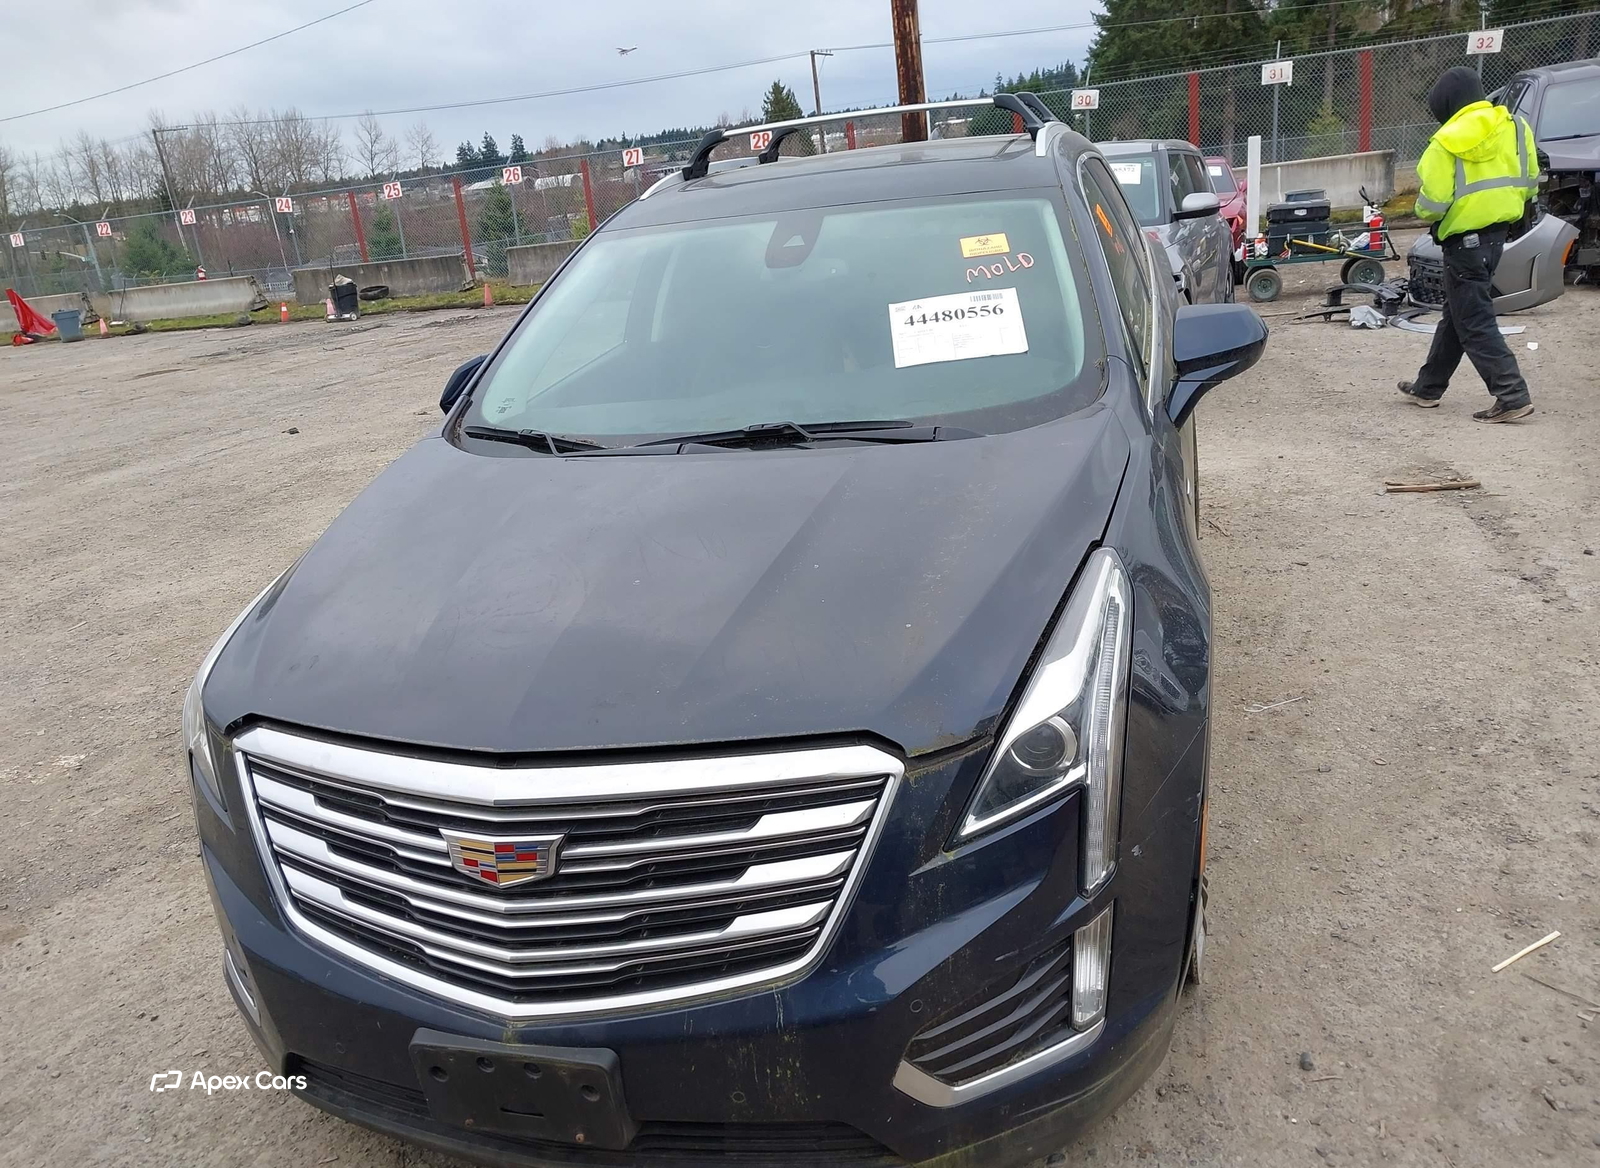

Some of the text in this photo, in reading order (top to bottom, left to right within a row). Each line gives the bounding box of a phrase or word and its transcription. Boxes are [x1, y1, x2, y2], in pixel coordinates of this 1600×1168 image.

[1476, 36, 1494, 50] 32
[1269, 68, 1283, 80] 31
[1077, 95, 1092, 106] 30
[752, 132, 770, 150] 28
[625, 149, 640, 166] 27
[504, 167, 520, 183] 26
[385, 183, 401, 198] 25
[277, 198, 291, 212] 24
[181, 211, 194, 224] 23
[97, 223, 111, 236] 22
[12, 234, 23, 247] 21
[966, 252, 1034, 283] MOLD
[904, 303, 1004, 326] 44480556
